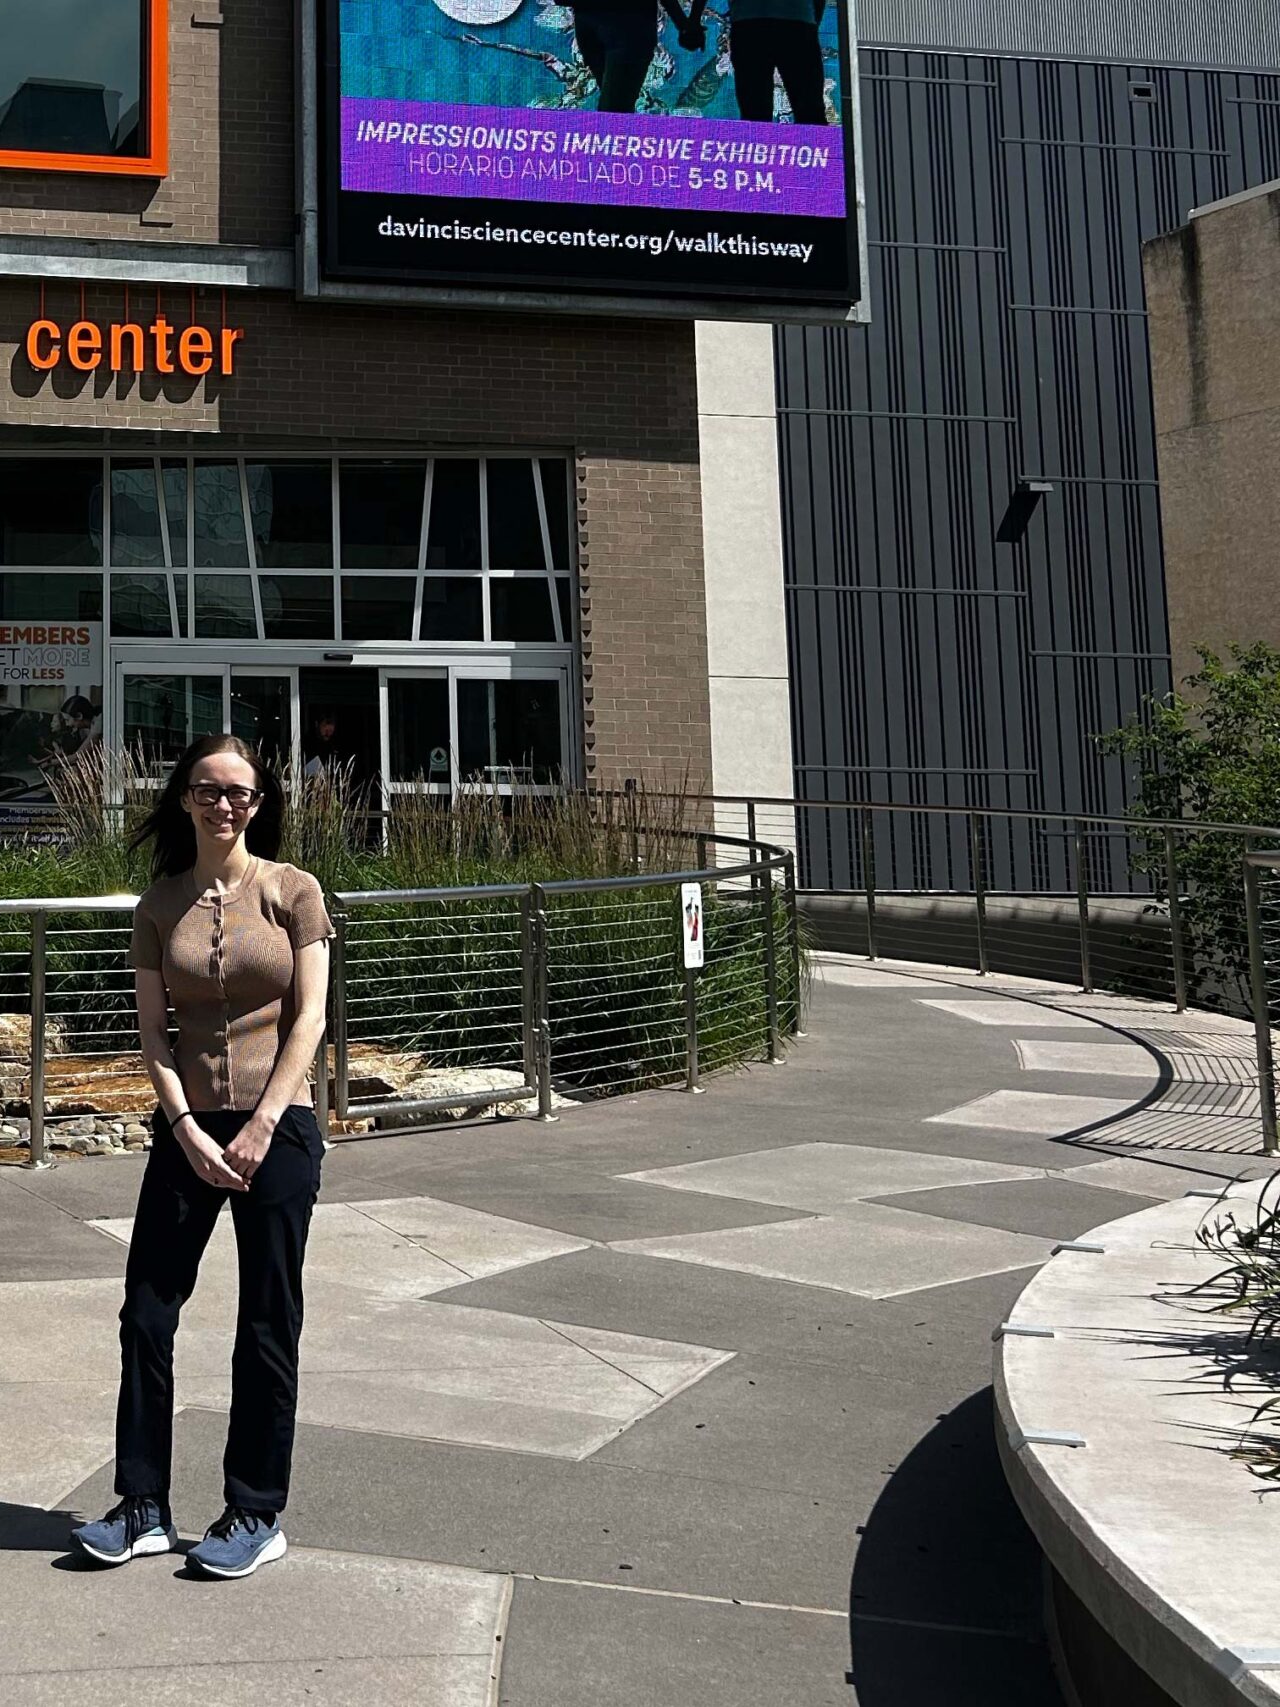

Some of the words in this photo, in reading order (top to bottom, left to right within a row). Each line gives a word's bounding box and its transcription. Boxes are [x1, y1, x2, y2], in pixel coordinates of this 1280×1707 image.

[356, 120, 557, 154] IMPRESSIONISTS
[563, 132, 695, 161] IMMERSIVE
[700, 140, 830, 169] EXHIBITION
[409, 152, 515, 179] HORARIO
[521, 158, 644, 187] AMPLIADO
[651, 165, 681, 188] DE
[688, 167, 728, 190] 5-8
[735, 170, 781, 194] P.M.
[378, 215, 814, 263] davincisciencecenter.org/walkthisway
[27, 312, 244, 375] center
[3, 668, 30, 680] FOR
[32, 668, 65, 680] LESS
[23, 648, 90, 667] MORE
